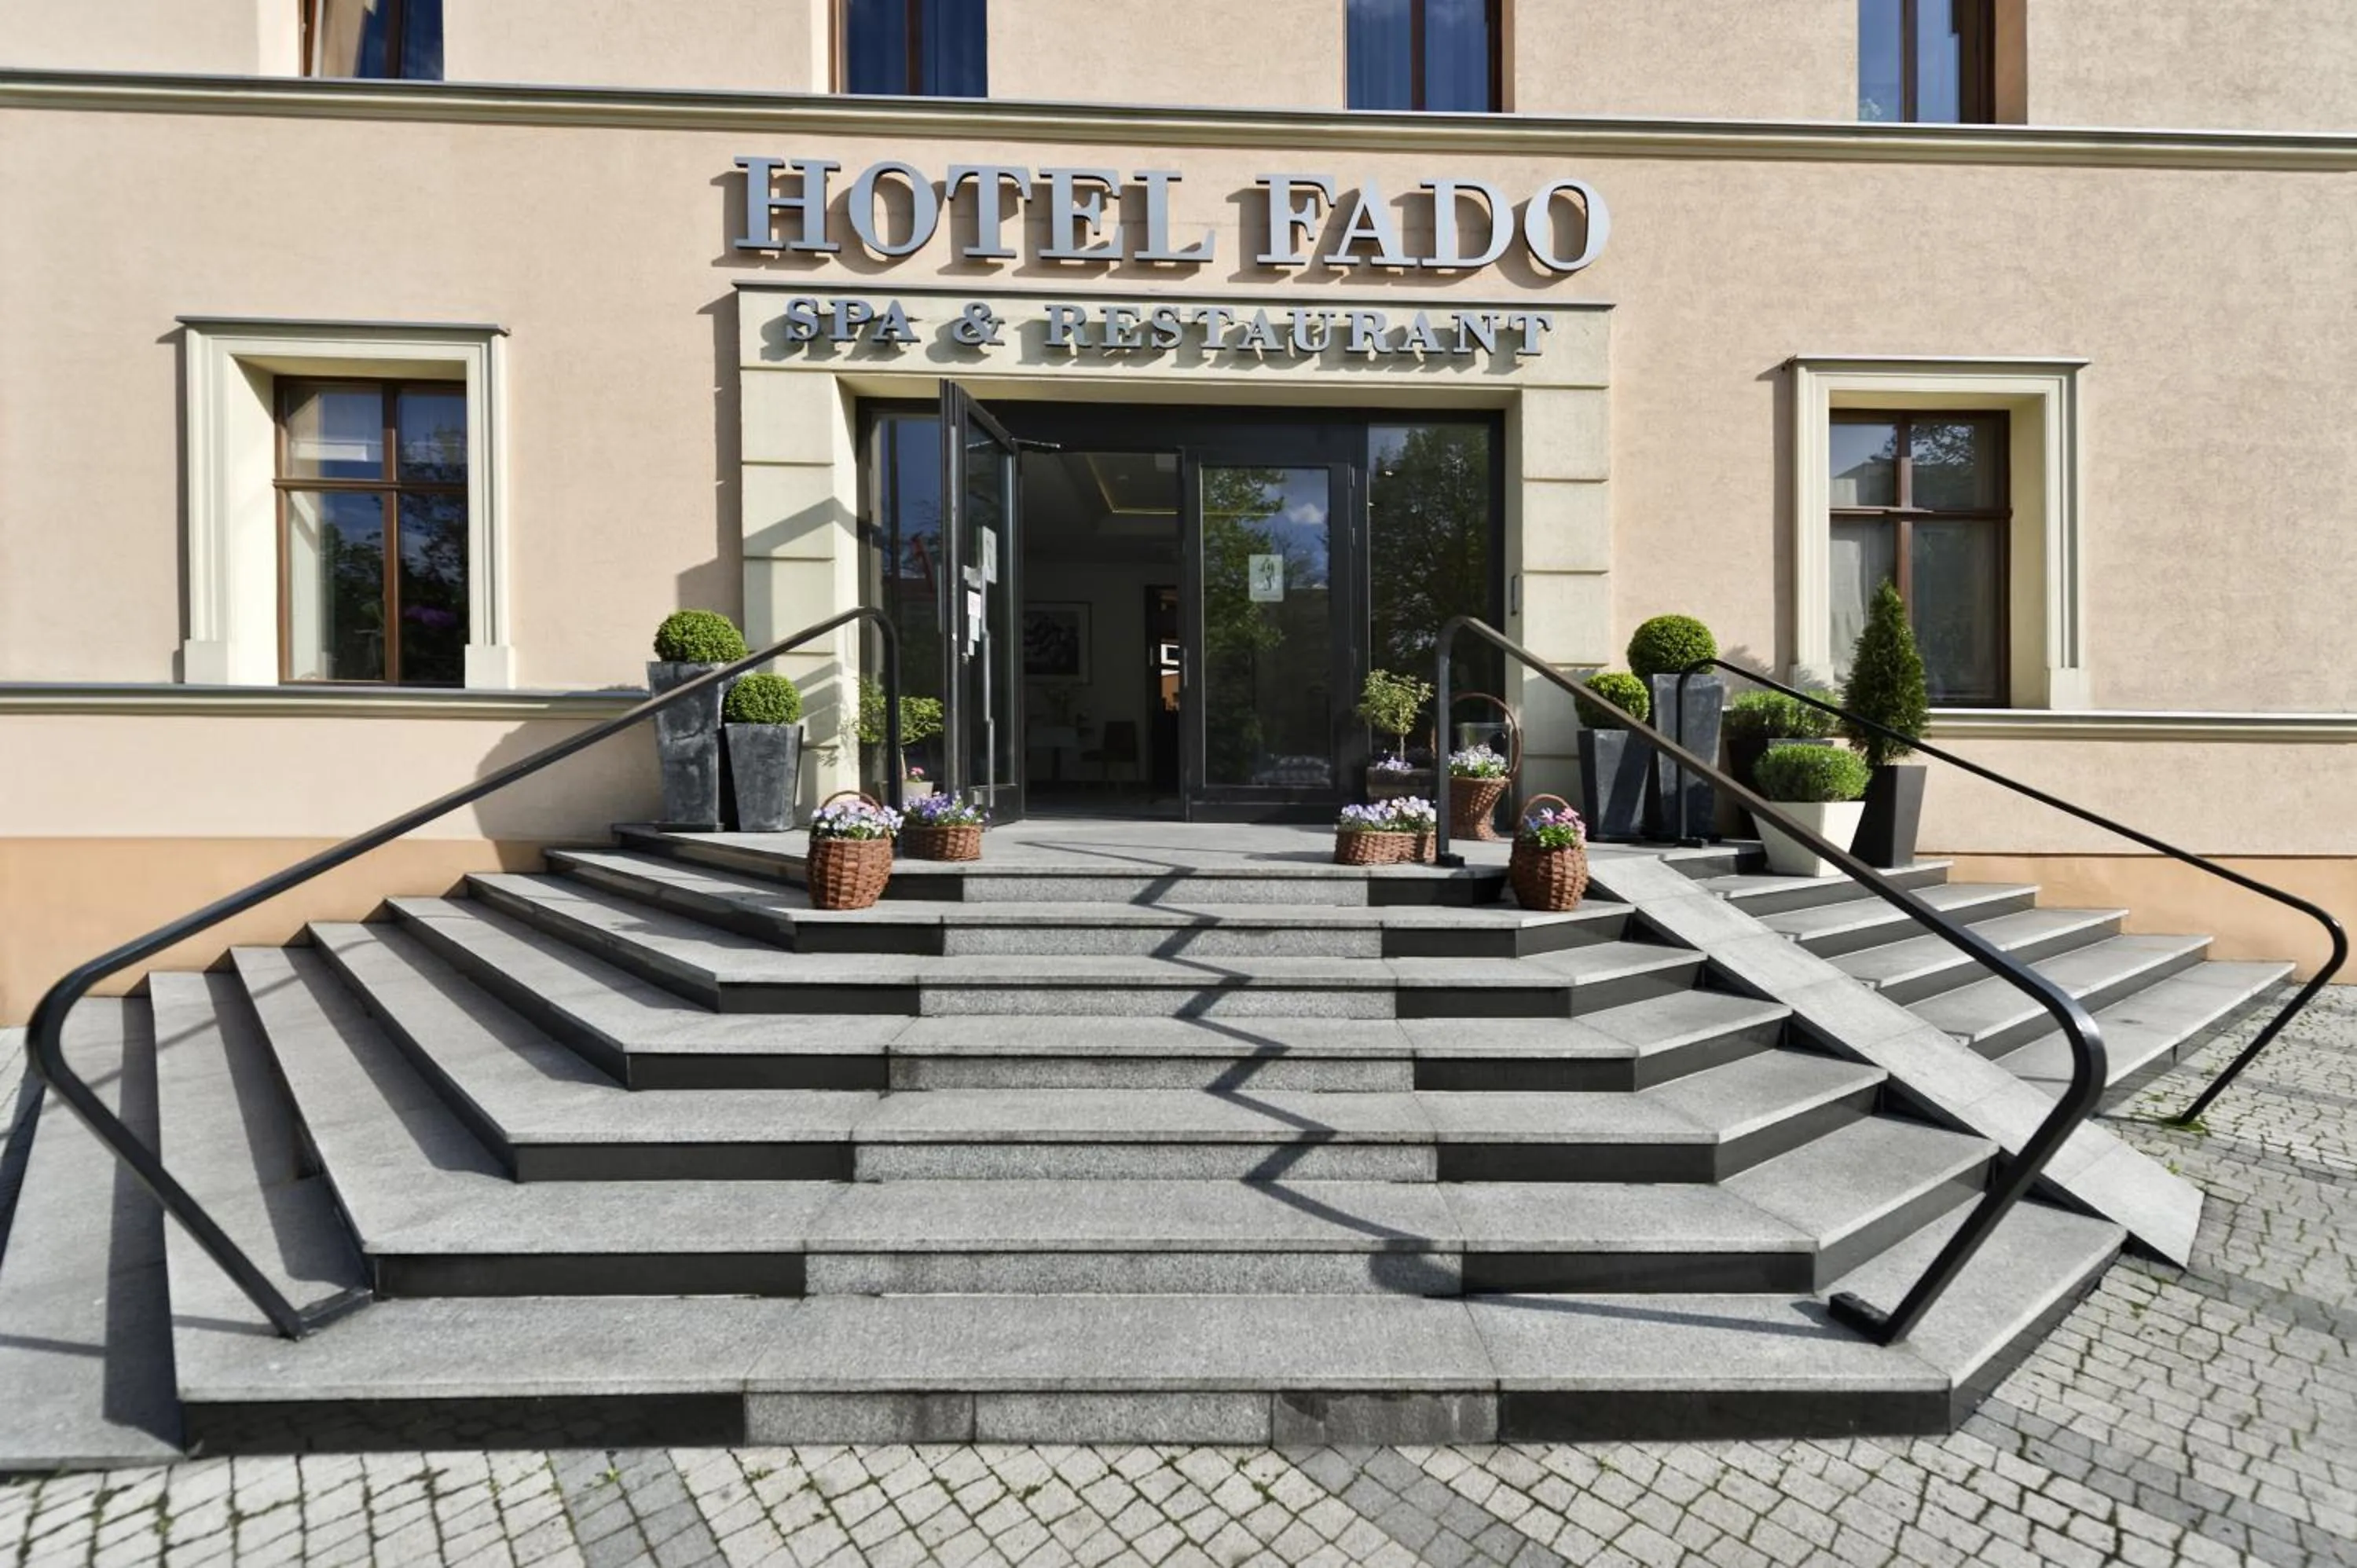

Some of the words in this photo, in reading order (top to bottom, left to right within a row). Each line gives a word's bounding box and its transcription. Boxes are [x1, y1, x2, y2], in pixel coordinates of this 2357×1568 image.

[733, 158, 1214, 262] HOTEL
[1255, 173, 1611, 271] FADO
[786, 299, 919, 343] SPA
[951, 302, 1005, 346] &
[1044, 305, 1552, 355] RESTAURANT
